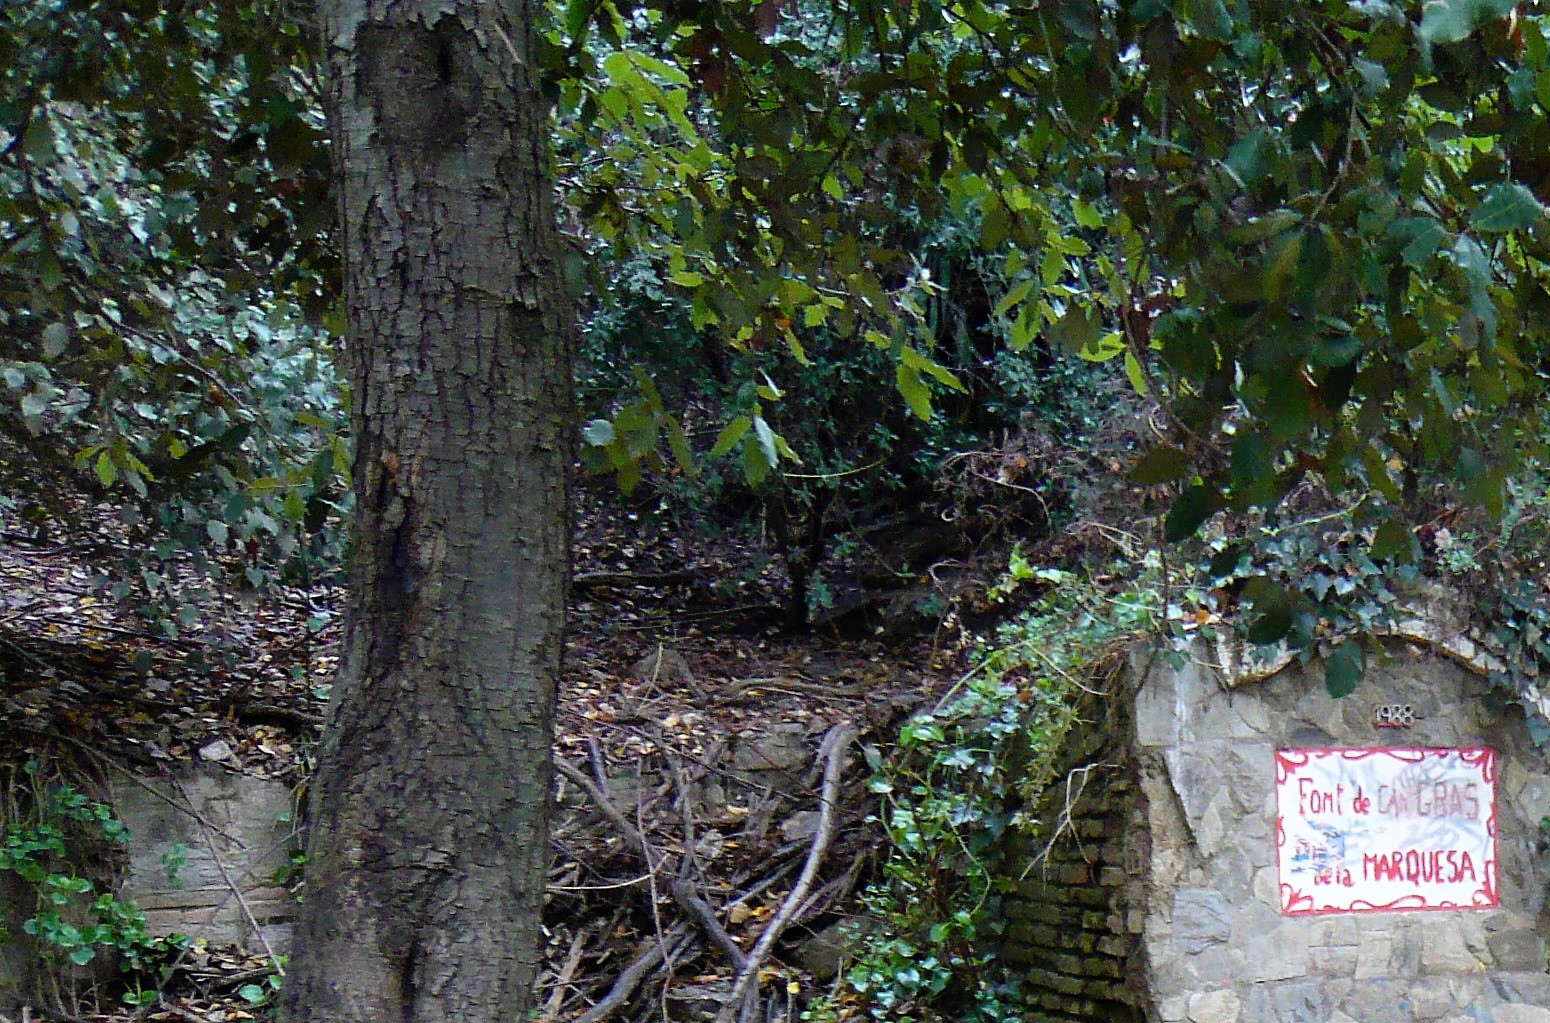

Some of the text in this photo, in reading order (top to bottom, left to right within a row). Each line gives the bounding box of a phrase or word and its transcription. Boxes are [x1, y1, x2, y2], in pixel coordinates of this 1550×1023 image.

[1298, 777, 1344, 816] Font
[1353, 784, 1371, 815] de
[1363, 849, 1476, 887] MARQUESA
